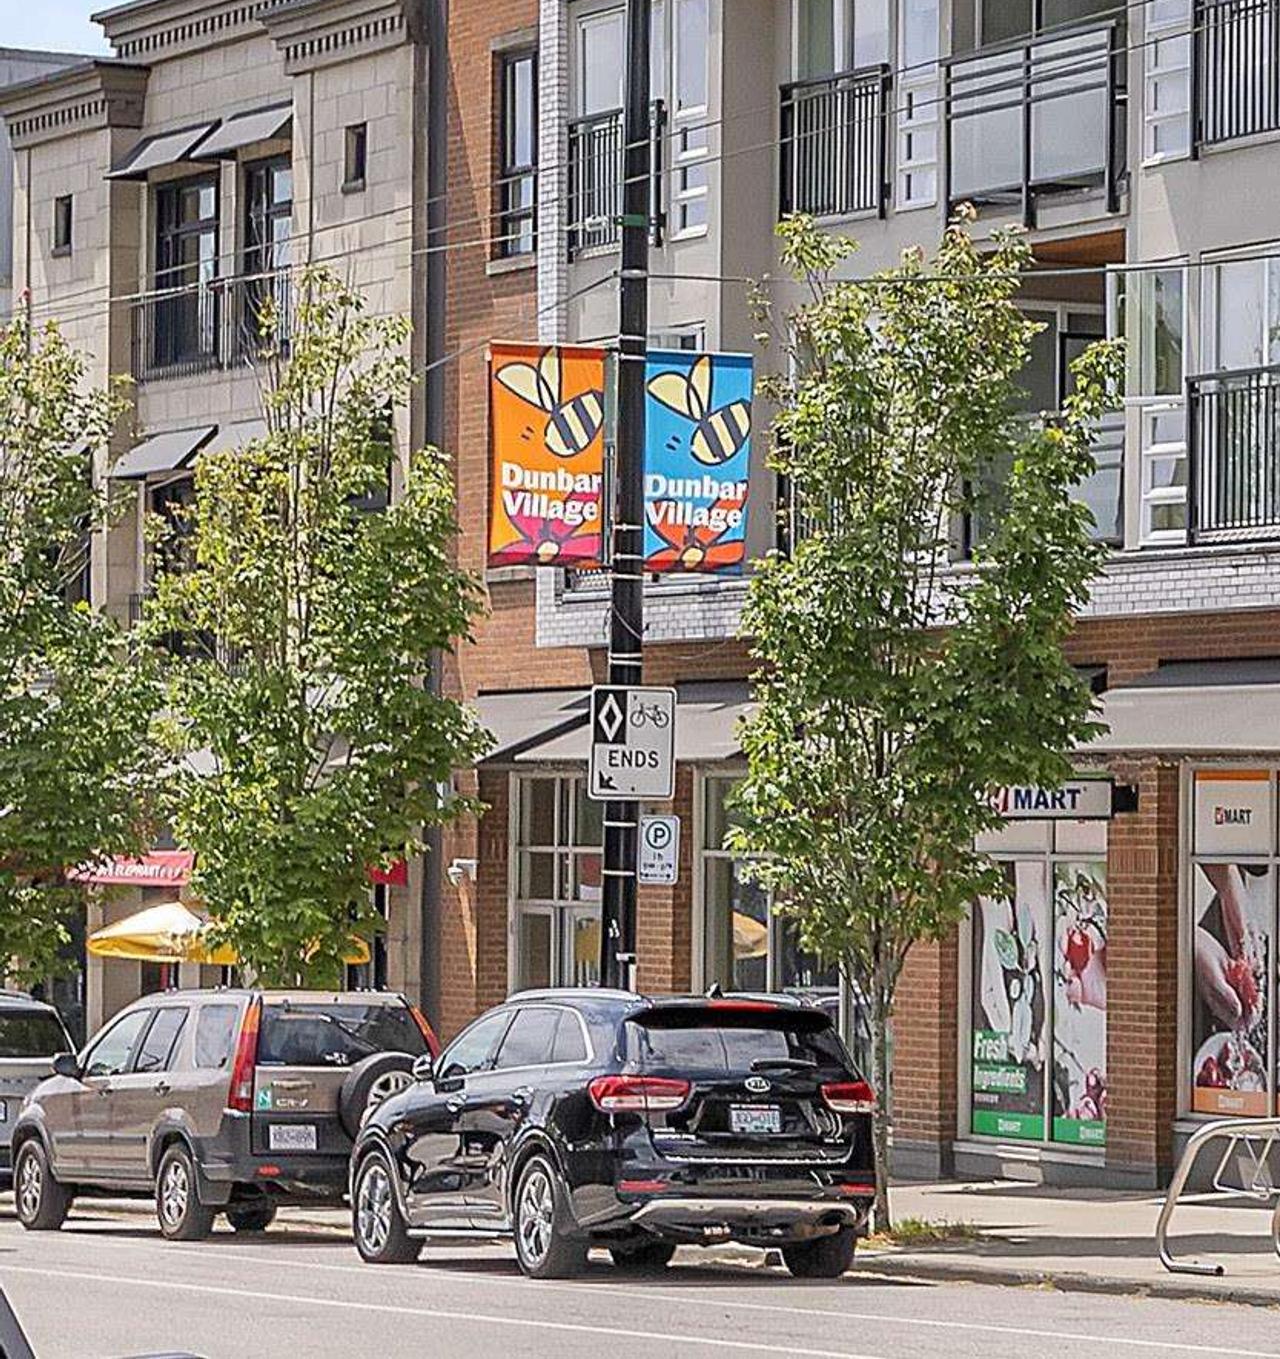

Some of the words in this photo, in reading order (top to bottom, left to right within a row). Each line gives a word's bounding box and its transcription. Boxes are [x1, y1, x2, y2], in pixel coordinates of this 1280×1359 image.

[501, 461, 601, 494] Dunbar
[646, 473, 748, 499] Dunbar
[503, 493, 599, 525] Village
[646, 500, 744, 529] Village
[608, 749, 659, 768] ENDS
[1014, 787, 1081, 810] MART
[653, 827, 666, 843] P
[974, 1030, 1008, 1060] Fresh
